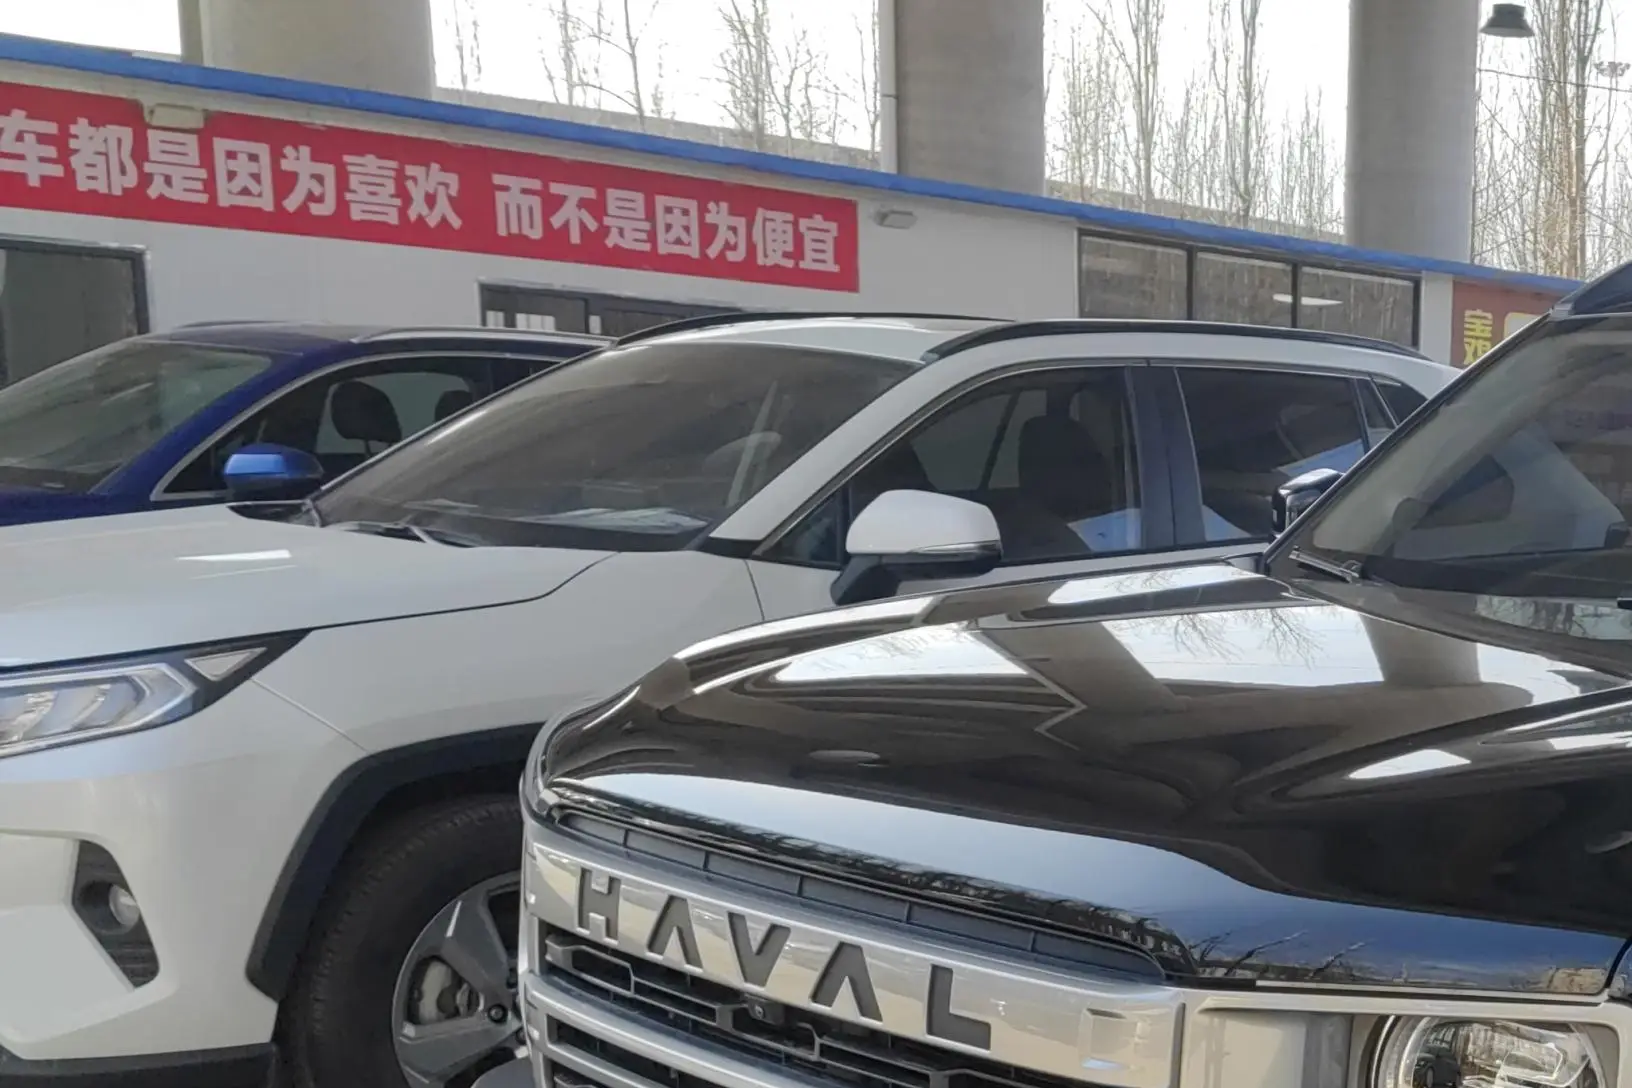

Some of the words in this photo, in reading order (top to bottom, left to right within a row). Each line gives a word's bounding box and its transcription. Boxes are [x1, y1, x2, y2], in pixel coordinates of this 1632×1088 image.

[0, 108, 462, 229] 车都是因为喜欢
[492, 173, 840, 273] 而不是因为便宜
[575, 867, 991, 1051] HAVAL
